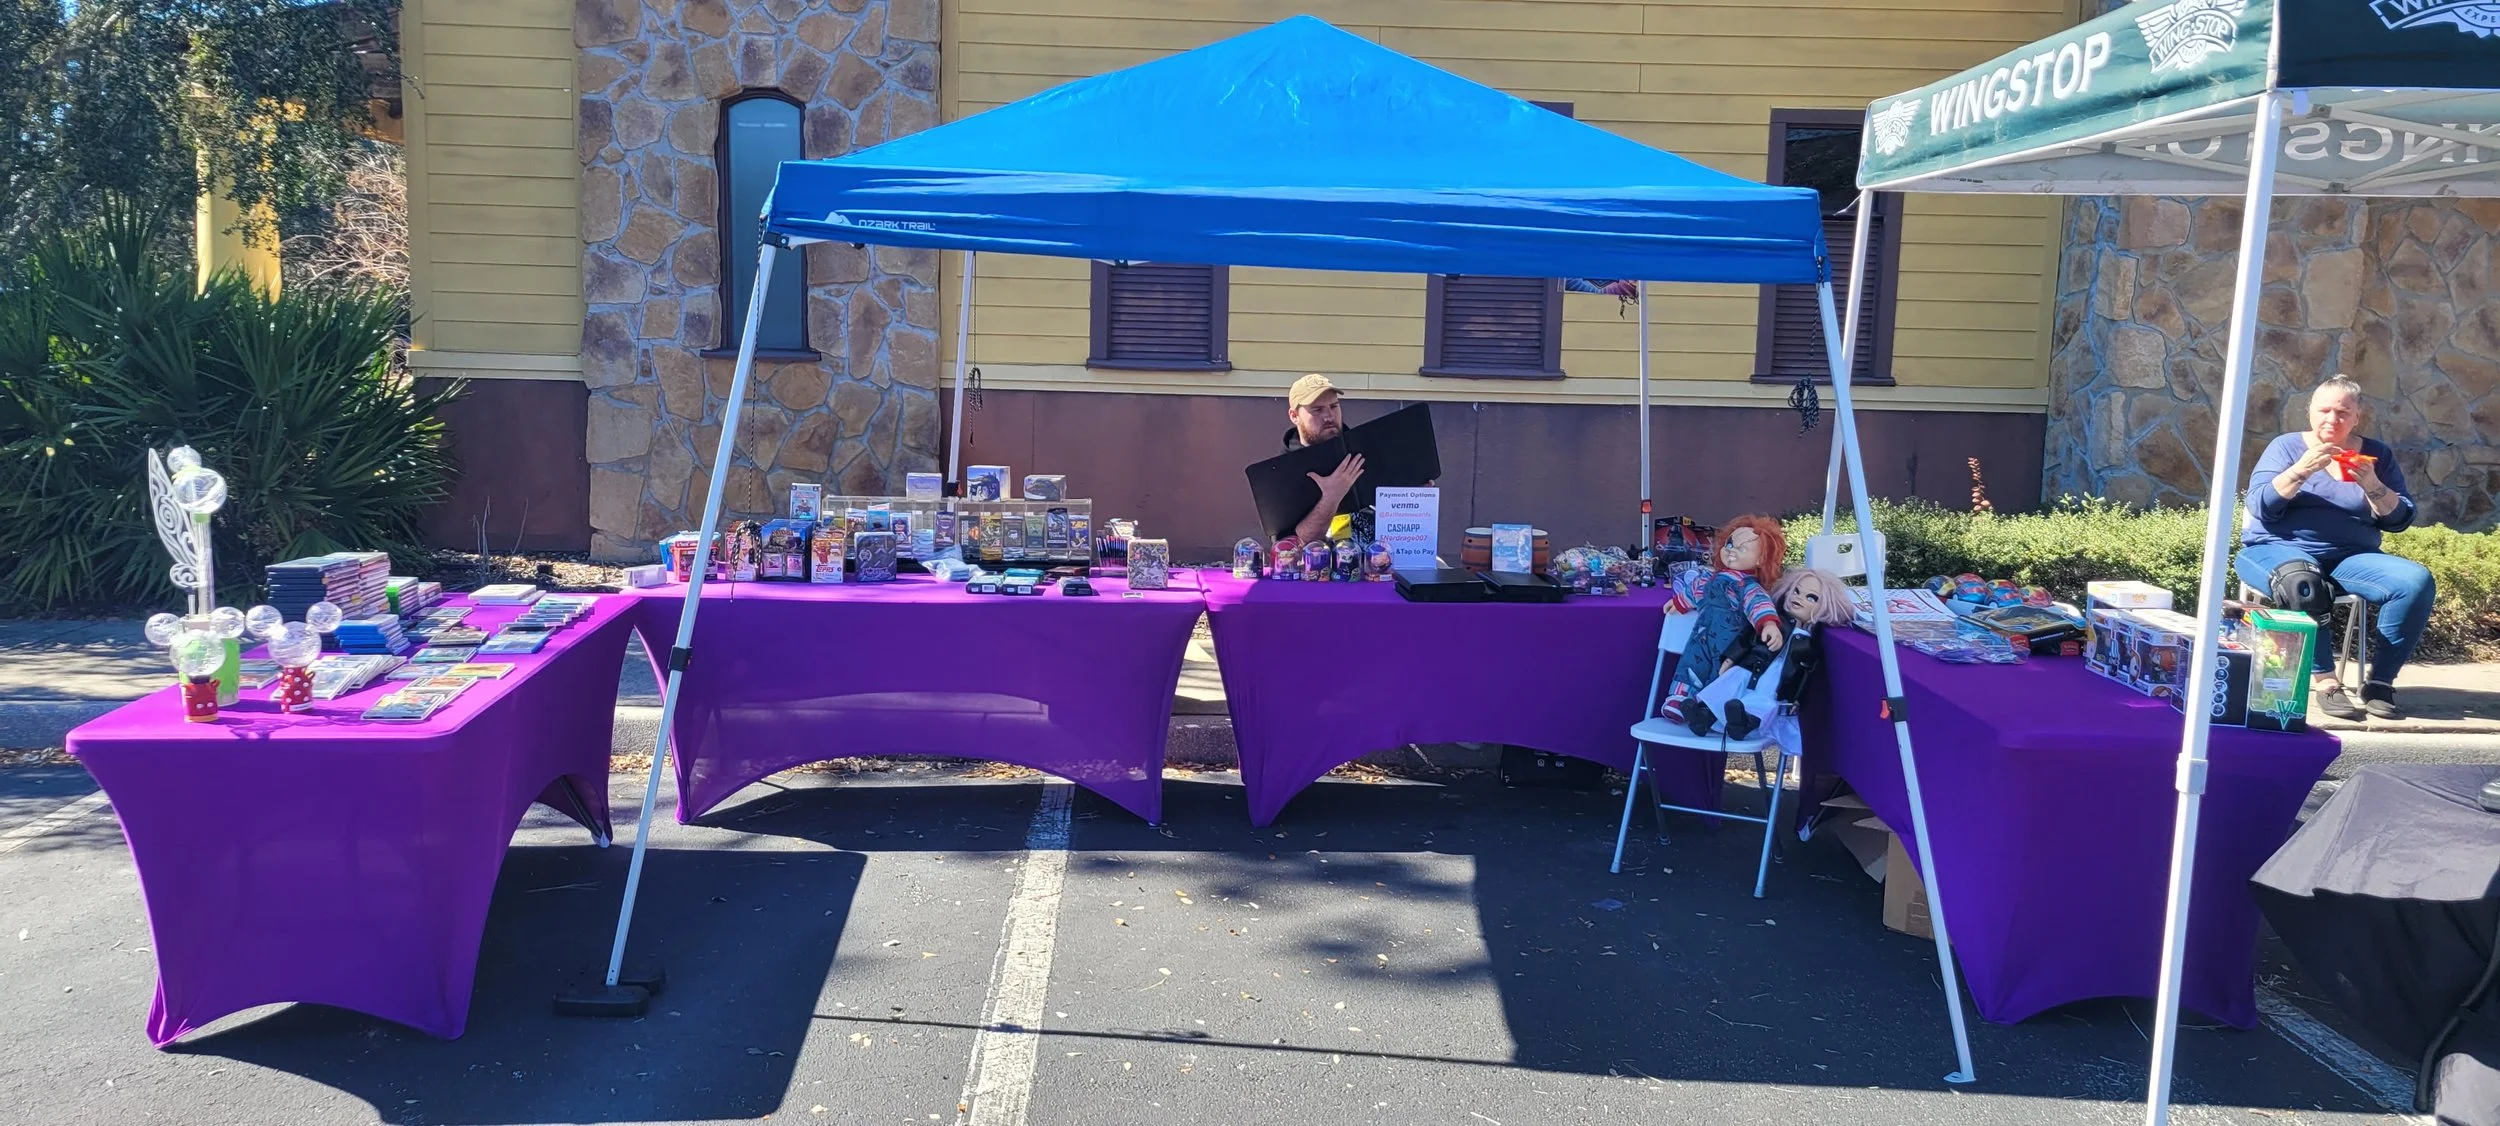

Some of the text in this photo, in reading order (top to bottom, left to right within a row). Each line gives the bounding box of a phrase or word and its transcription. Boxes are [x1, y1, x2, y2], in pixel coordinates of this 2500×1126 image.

[2464, 8, 2500, 23] EXPE
[1930, 31, 2111, 136] WINGSTOP
[858, 219, 933, 231] OZARK TRAIL
[1387, 524, 1421, 533] CASHAPP
[1422, 548, 1435, 556] Pay
